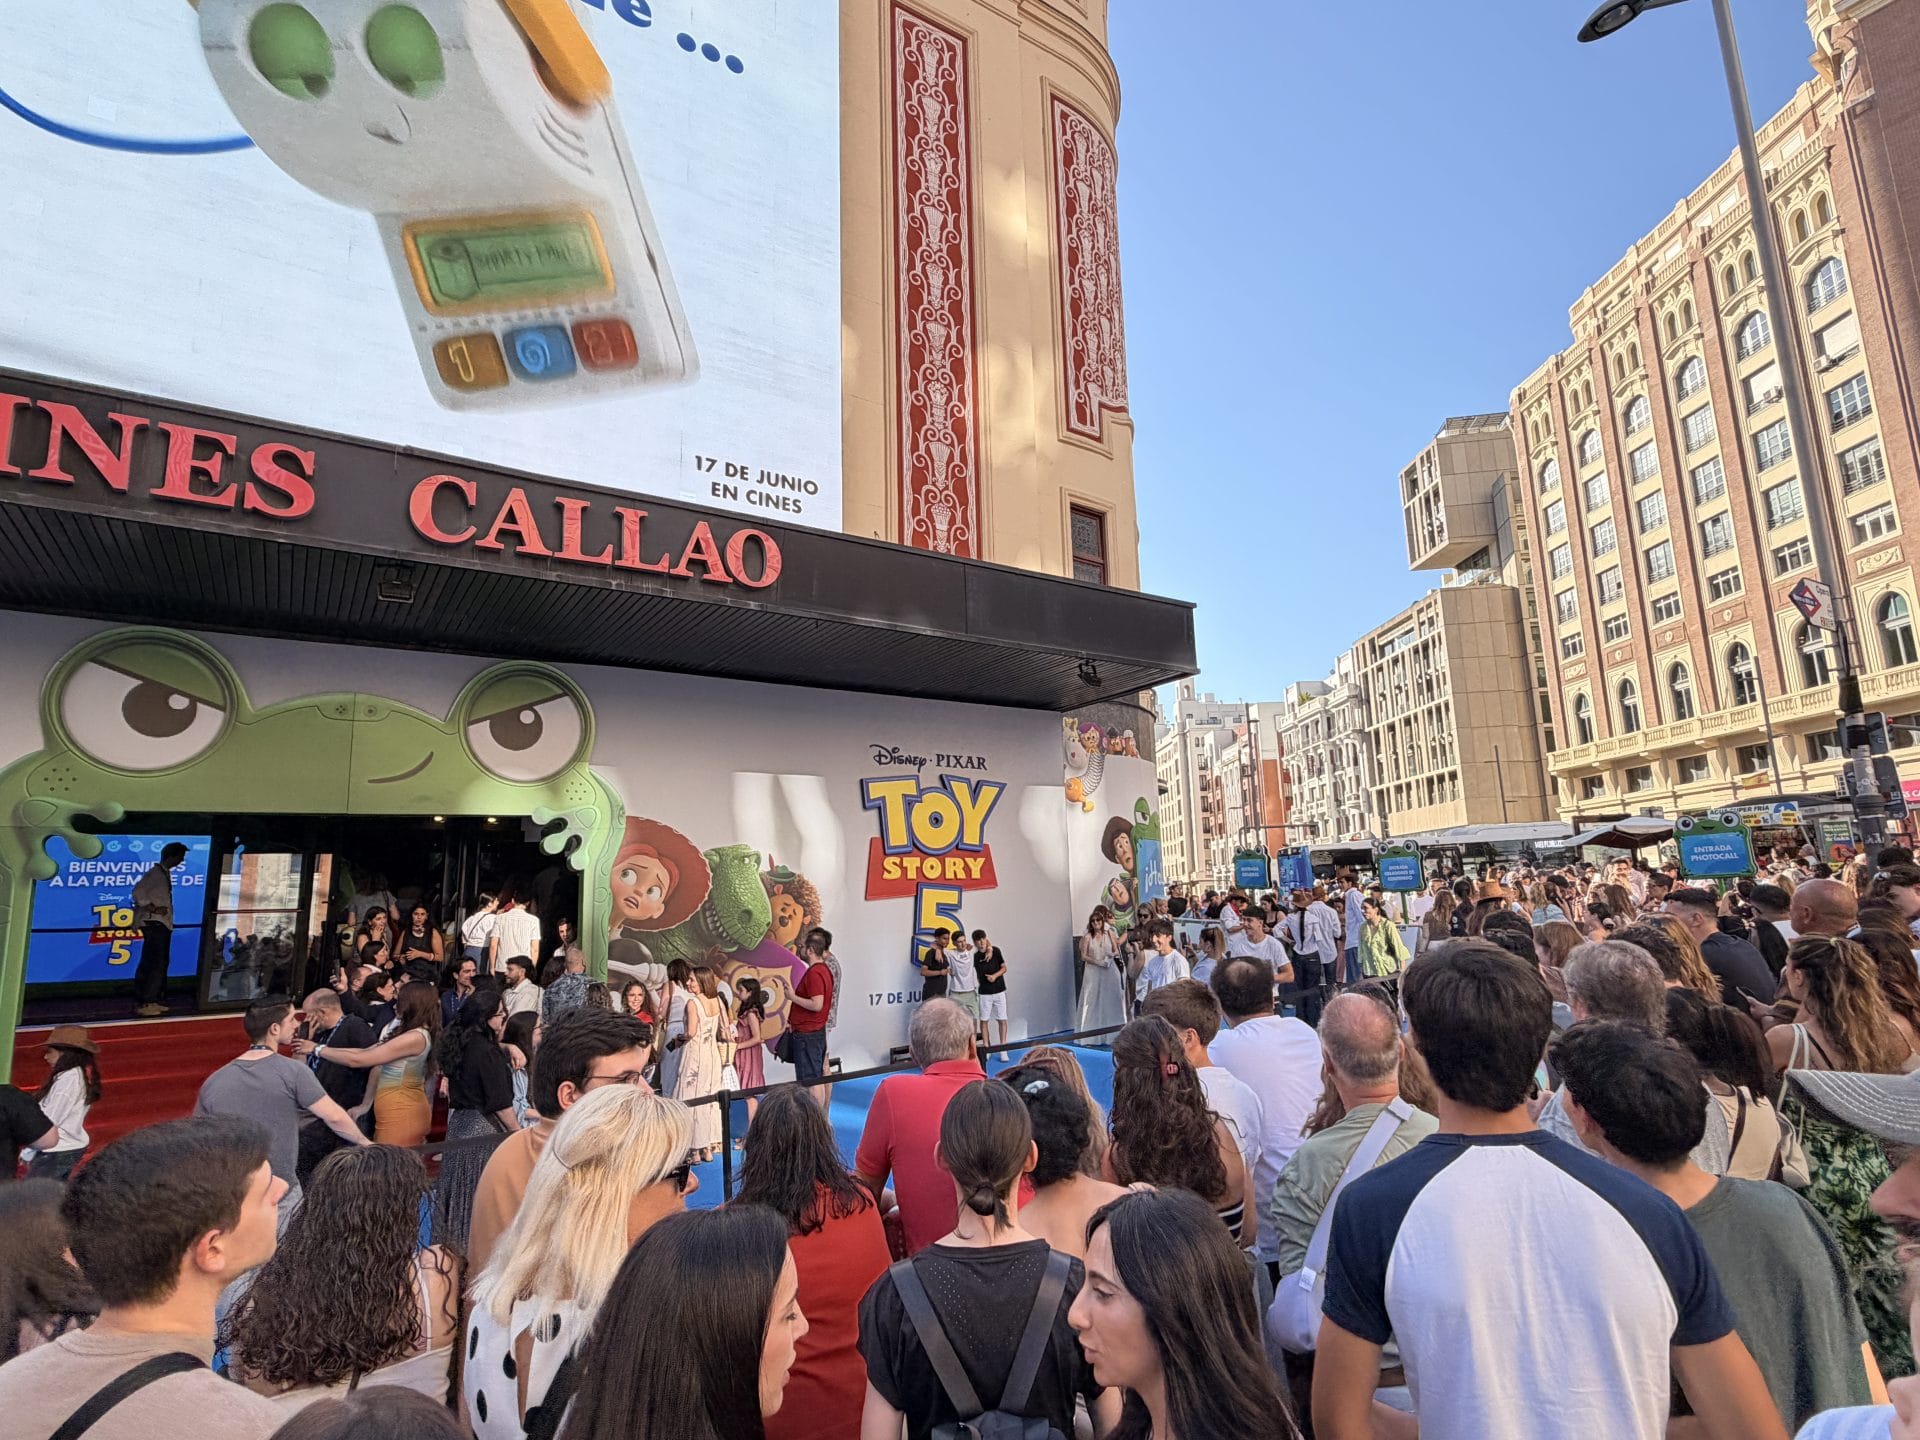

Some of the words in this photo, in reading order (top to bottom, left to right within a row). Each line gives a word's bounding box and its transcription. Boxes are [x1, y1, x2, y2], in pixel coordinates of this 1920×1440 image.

[695, 455, 718, 472] 17
[725, 462, 749, 481] DE
[756, 470, 819, 495] JUNIO
[711, 481, 738, 501] EN
[745, 489, 802, 513] CINES
[409, 474, 783, 588] CALLAO
[869, 743, 927, 773] Disney
[936, 753, 988, 771] PIXAR
[861, 774, 1006, 855] TOY
[1691, 852, 1739, 861] PHOTOCALL
[1694, 844, 1732, 853] ENTRADA
[69, 861, 186, 873] BIENVENIS
[882, 856, 986, 880] STORY
[49, 875, 64, 887] A
[67, 875, 89, 887] LA
[93, 874, 178, 887] PREME
[182, 874, 204, 887] DE
[93, 904, 135, 927] TO
[911, 882, 965, 968] 5
[108, 940, 131, 965] 5
[869, 993, 883, 1006] 17
[888, 991, 903, 1004] DE
